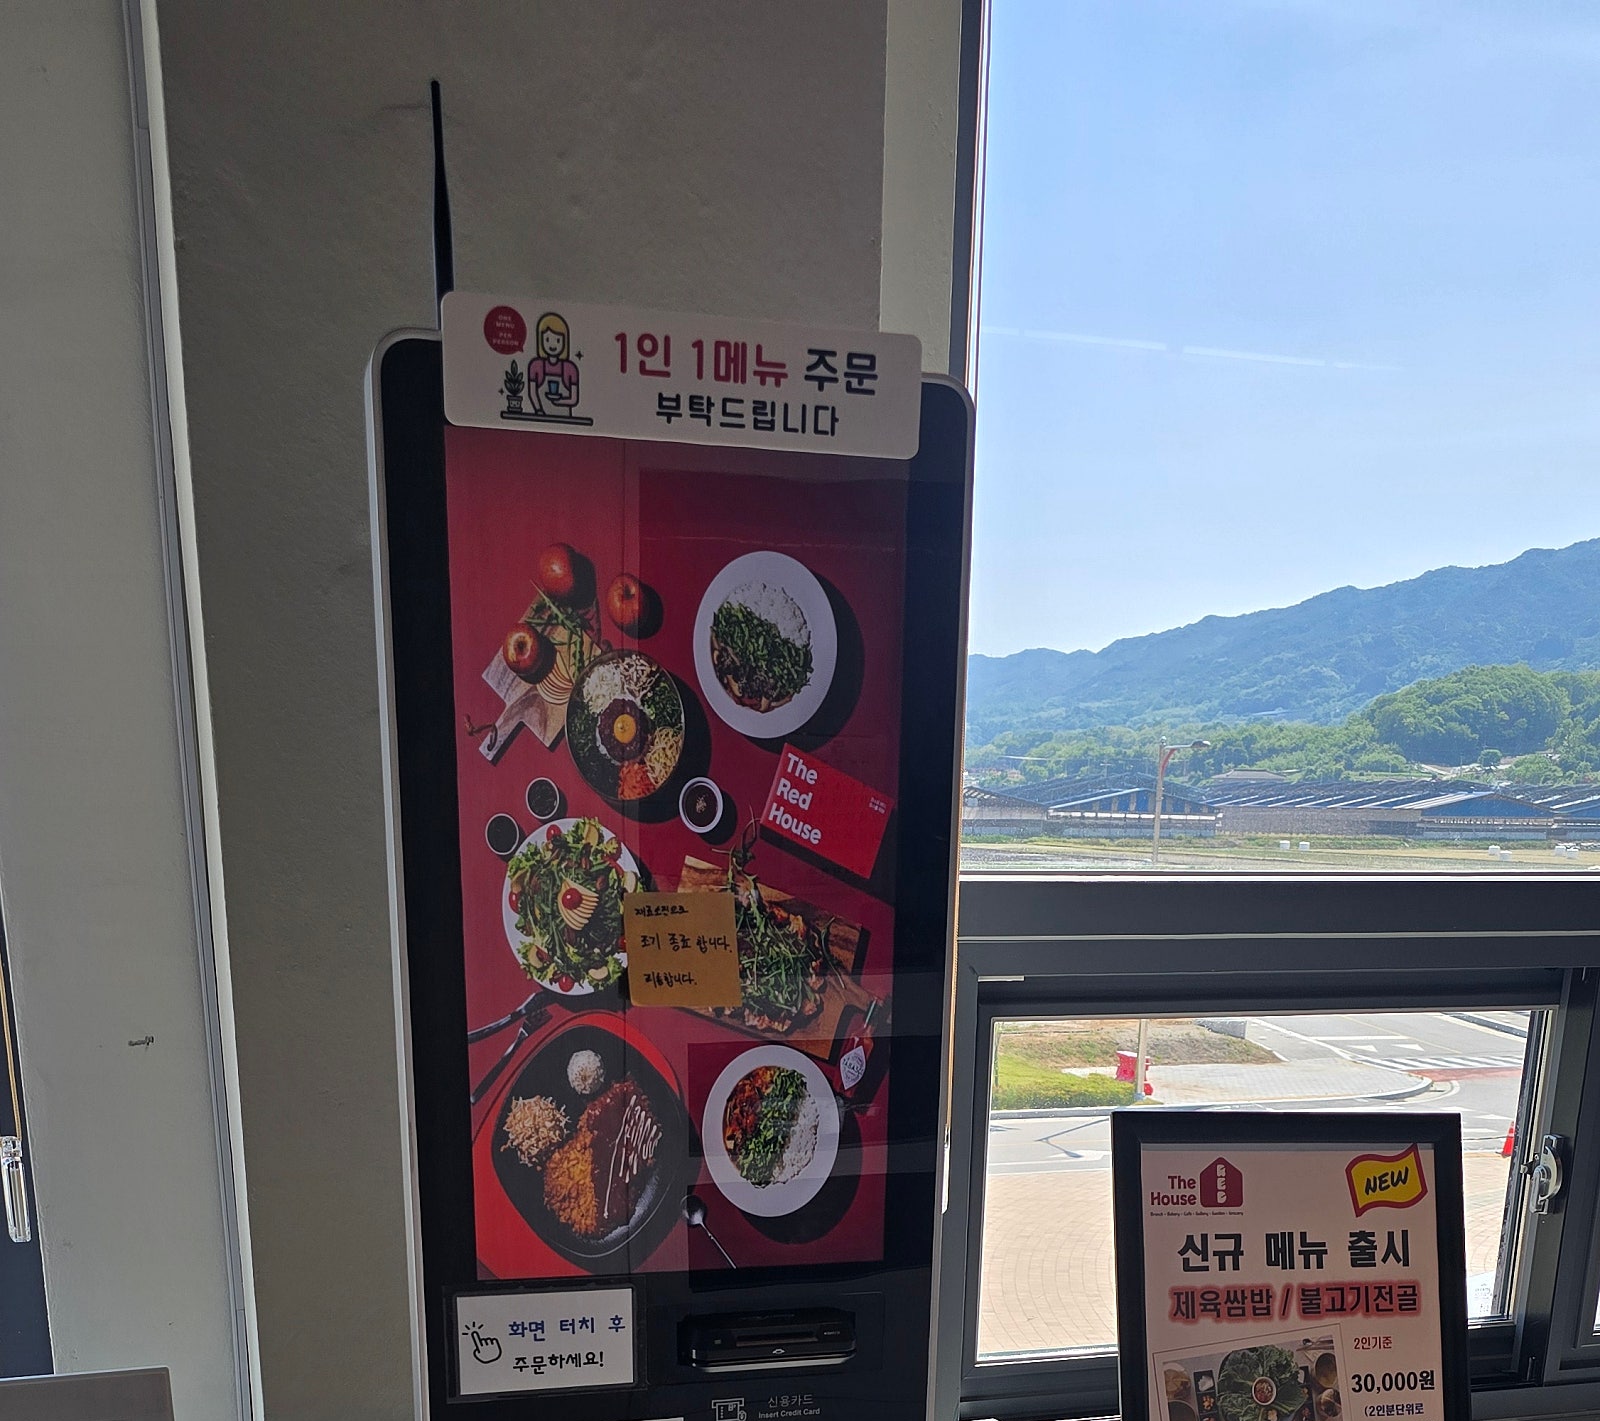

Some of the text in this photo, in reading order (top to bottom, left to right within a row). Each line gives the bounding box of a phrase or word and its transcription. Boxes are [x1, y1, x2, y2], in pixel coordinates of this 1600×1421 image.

[615, 332, 878, 396] 1인 1메뉴 주문
[656, 392, 839, 437] 부탁드립니다
[788, 752, 818, 785] The
[776, 777, 813, 811] Red
[768, 802, 822, 845] House
[640, 932, 732, 953] 조기 종료 합니다.
[1168, 1175, 1196, 1189] The
[1216, 1164, 1227, 1204] RED
[1363, 1167, 1409, 1195] NEW
[1150, 1191, 1197, 1206] House
[1177, 1229, 1410, 1272] 신규 메뉴 출시
[1173, 1288, 1273, 1320] 제육쌈밥
[1300, 1284, 1418, 1315] 불고기전골
[508, 1315, 626, 1342] 화면 터치 후
[1354, 1336, 1393, 1350] 2인기준
[513, 1351, 604, 1375] 주문하세요!
[1351, 1370, 1435, 1394] 30,000원
[758, 1407, 821, 1419] Insert Credit Card
[767, 1394, 814, 1408] 신용카드
[1364, 1402, 1425, 1417] (2인분단위로
